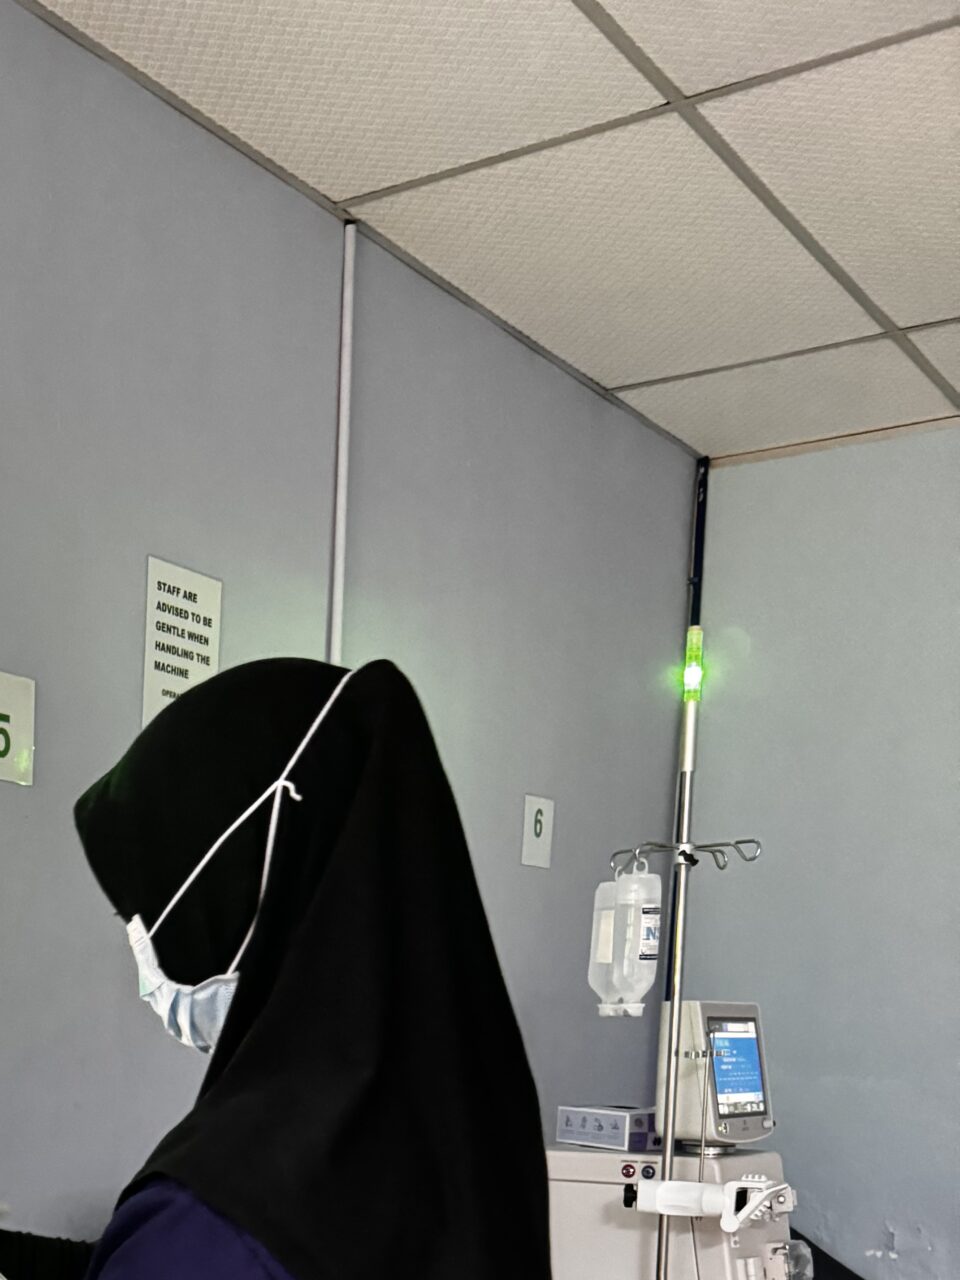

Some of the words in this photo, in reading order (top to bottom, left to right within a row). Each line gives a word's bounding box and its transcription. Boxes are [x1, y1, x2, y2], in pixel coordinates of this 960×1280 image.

[156, 580, 181, 598] STAFF
[182, 590, 198, 604] ARE
[155, 600, 190, 621] ADVISED
[190, 612, 201, 625] TO
[202, 616, 213, 629] BE
[155, 620, 186, 640] GENTLE
[186, 630, 209, 646] WHEN
[155, 640, 194, 662] HANDLING
[195, 652, 211, 667] THE
[154, 660, 189, 680] MACHINE
[533, 807, 543, 839] 6
